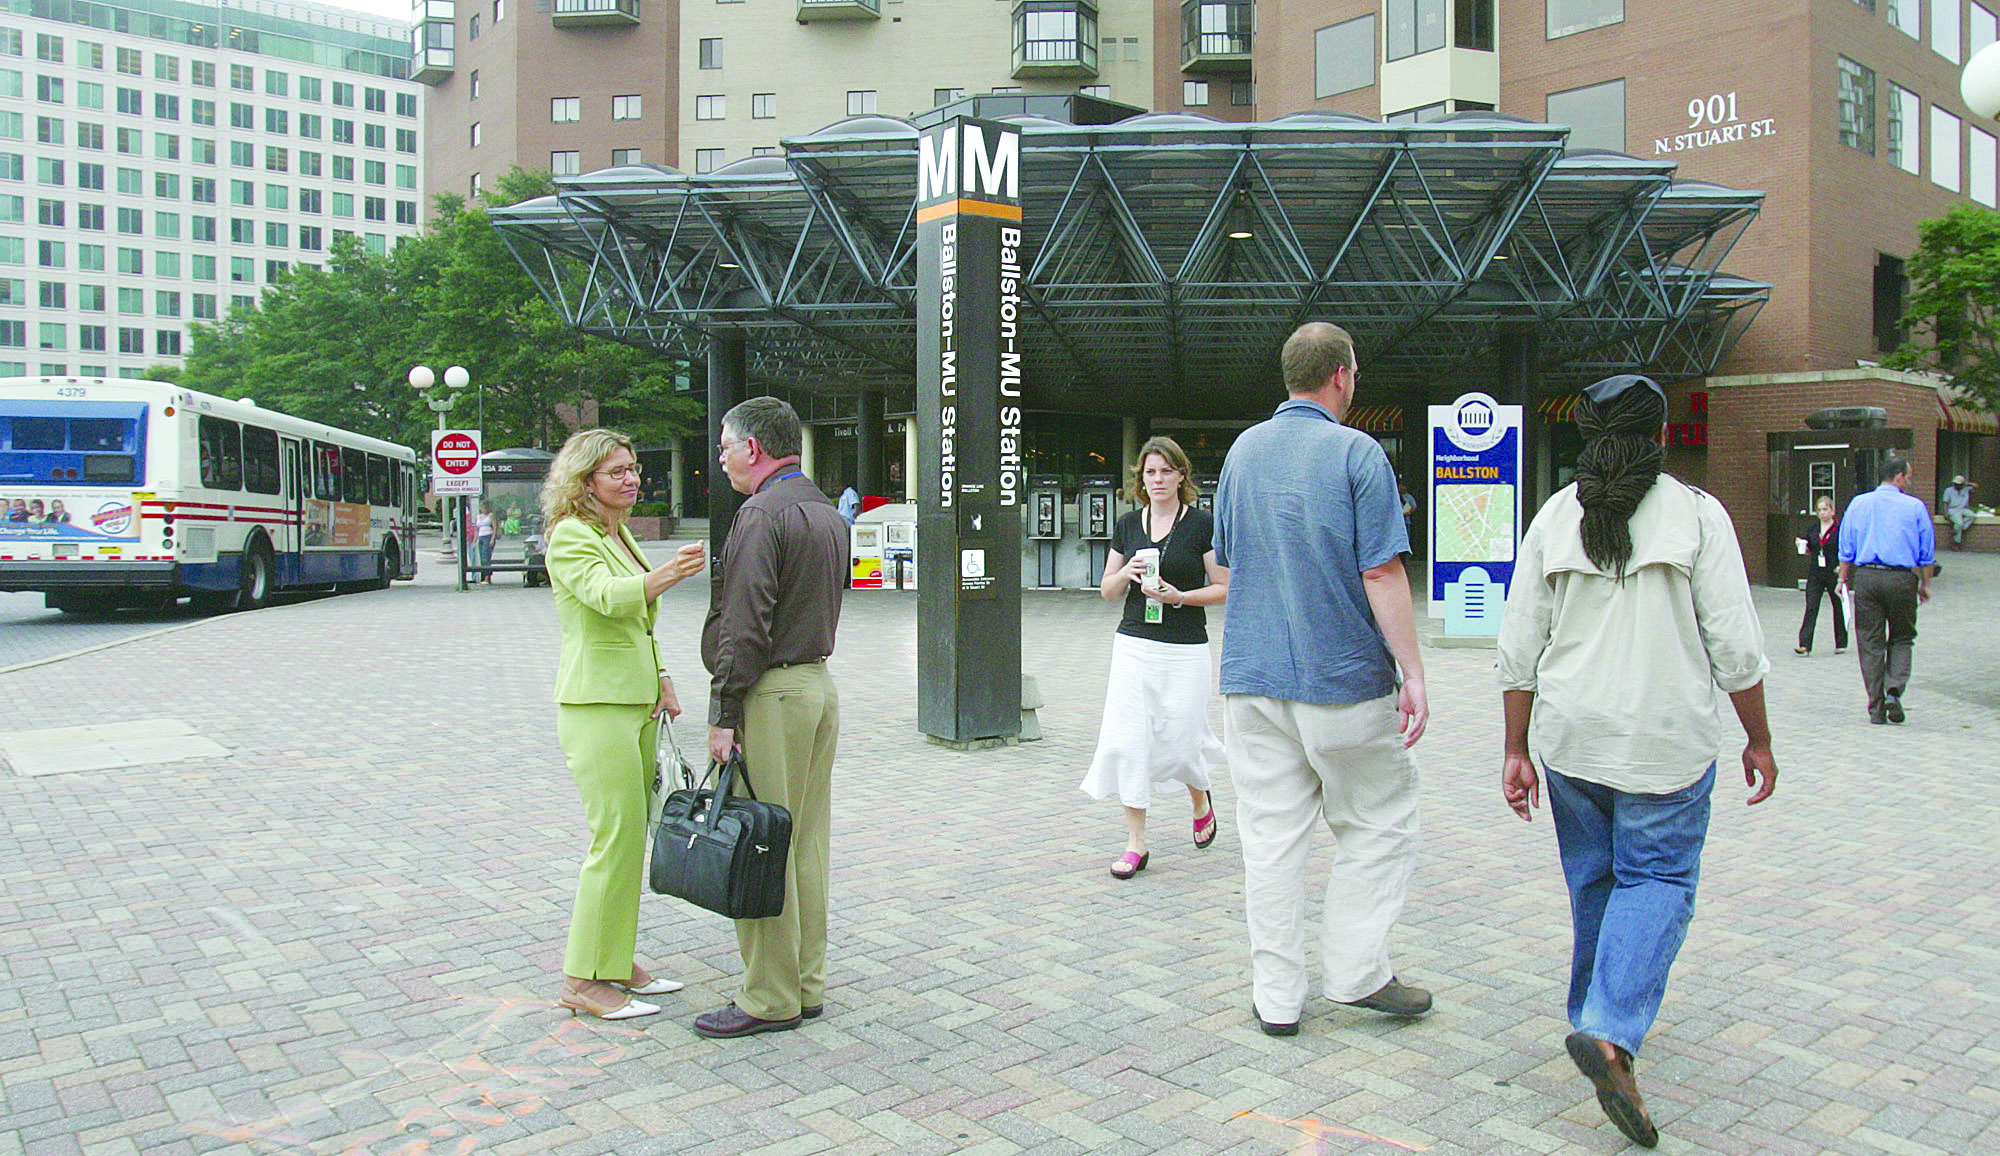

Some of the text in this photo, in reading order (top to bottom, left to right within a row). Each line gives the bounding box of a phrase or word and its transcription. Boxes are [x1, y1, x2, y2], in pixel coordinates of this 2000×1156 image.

[1687, 91, 1738, 129] 901
[1655, 118, 1776, 154] N. STUART ST.
[919, 126, 956, 202] M
[963, 123, 1019, 198] M
[56, 387, 86, 397] 4379
[834, 427, 852, 437] Tivoli
[941, 406, 956, 507] Station
[1000, 406, 1021, 506] Station
[1436, 466, 1499, 479] BALLSTON
